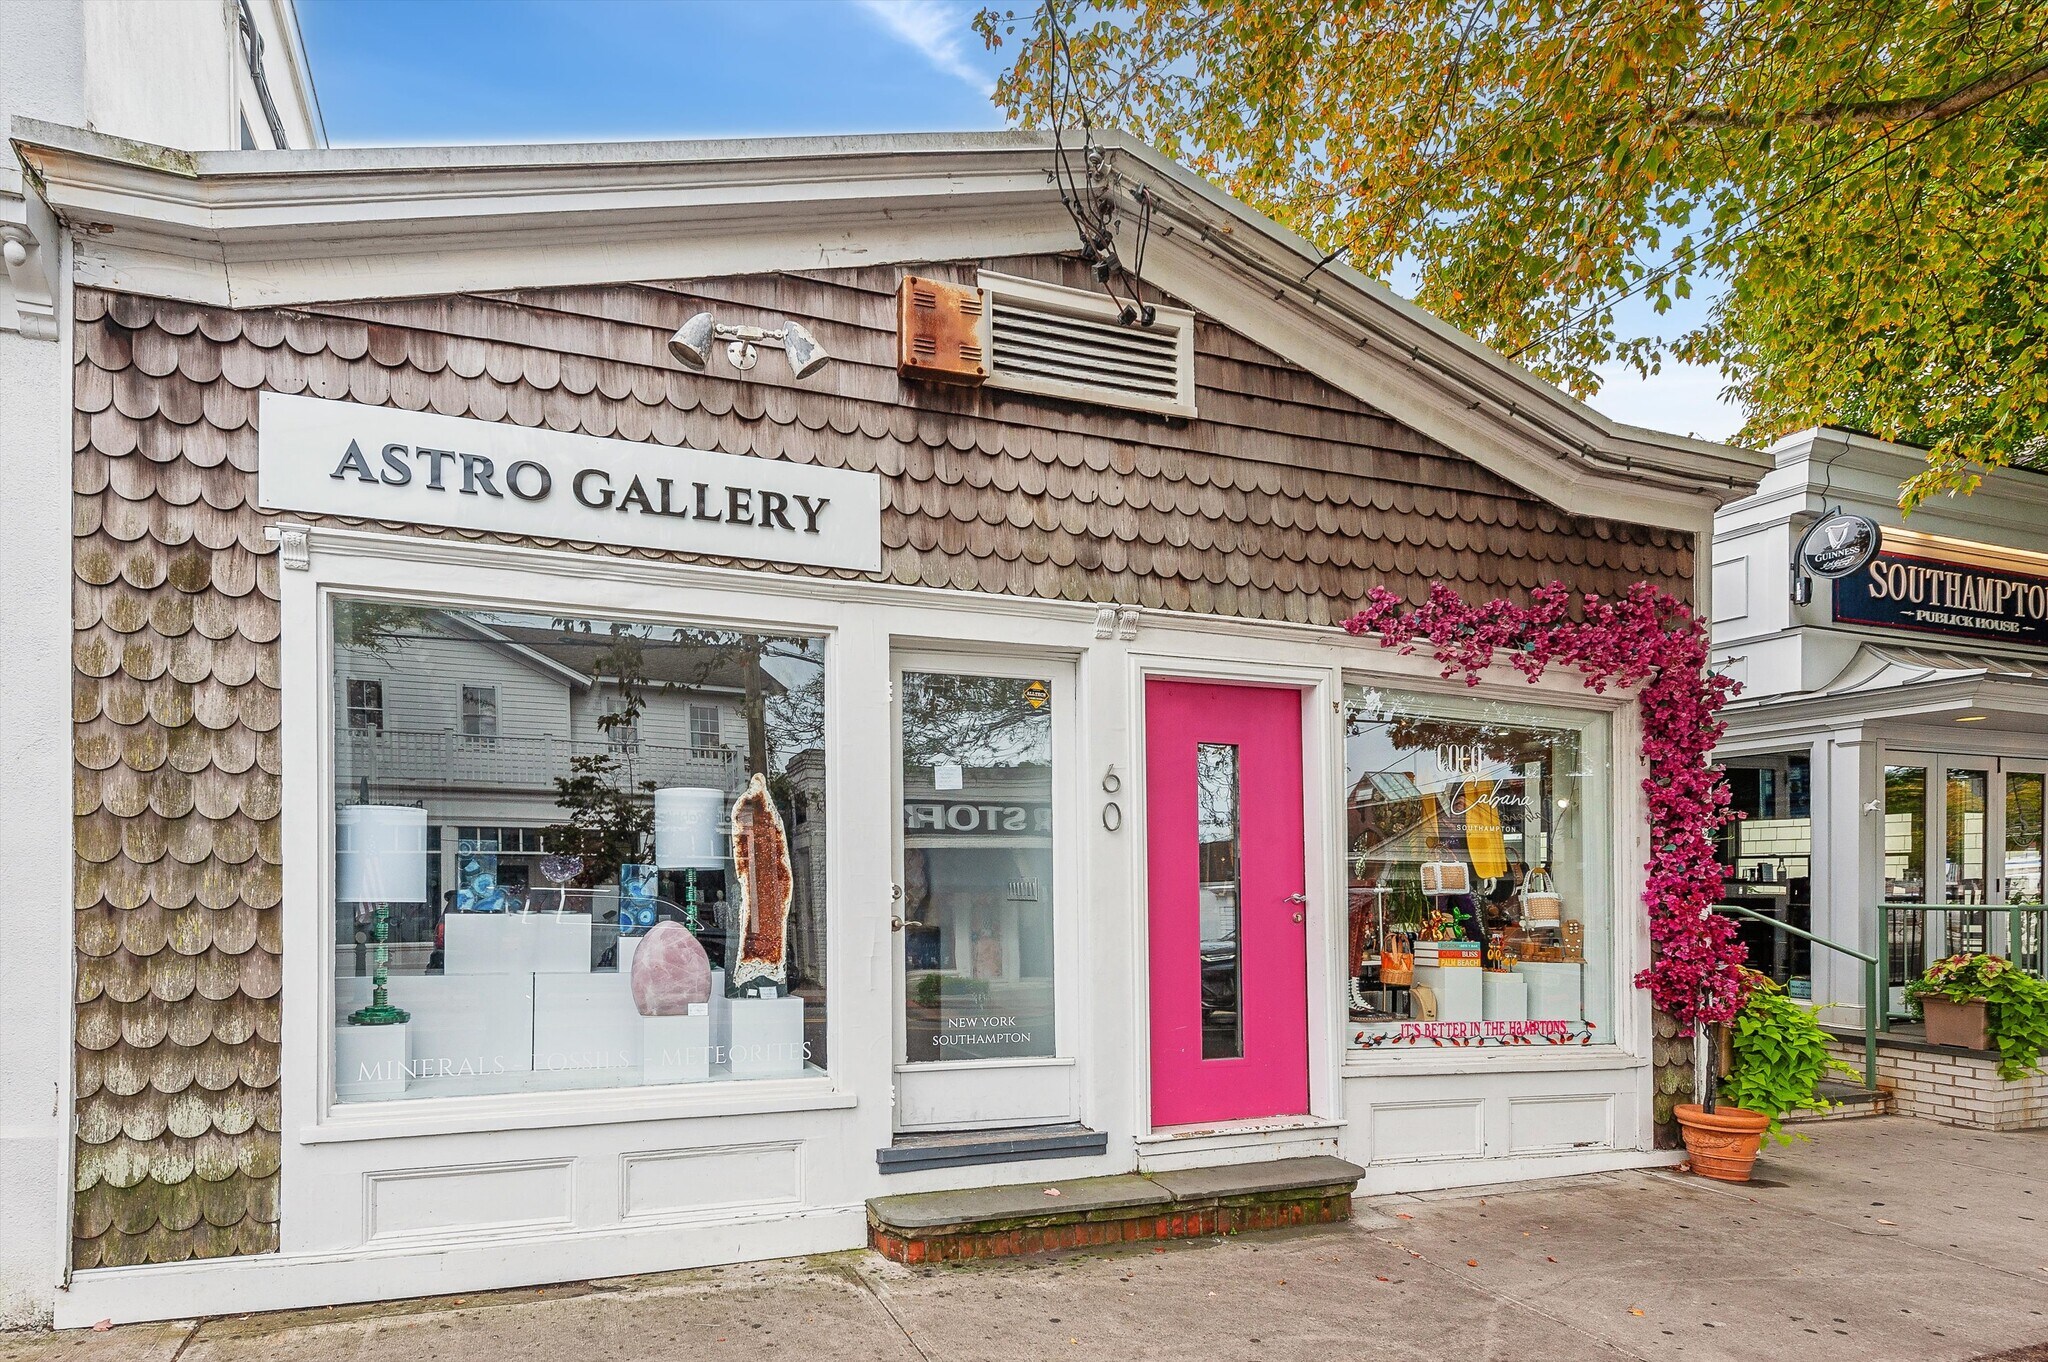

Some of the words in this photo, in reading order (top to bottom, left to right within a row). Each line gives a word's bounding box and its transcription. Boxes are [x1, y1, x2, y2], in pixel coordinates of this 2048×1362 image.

[329, 438, 552, 502] ASTRO
[572, 468, 830, 534] GALLERY
[1815, 546, 1861, 563] GUINNESS
[1868, 560, 2048, 621] SOUTHAMPTO
[1916, 609, 1974, 628] PUBLICK
[1975, 618, 2020, 633] HOUSE
[1437, 743, 1481, 774] COCO
[1451, 774, 1534, 815] Cabana
[1456, 824, 1517, 833] SOUTHAMPTON
[1457, 959, 1479, 967] BEACH
[948, 1018, 978, 1029] NEW
[981, 1016, 1017, 1027] YORK
[1401, 1023, 1421, 1039] IT'S
[1424, 1021, 1467, 1039] BETTER
[1470, 1022, 1481, 1037] IN
[1484, 1021, 1506, 1036] THE
[932, 1032, 1031, 1047] SOUTHAMPTON
[357, 1055, 505, 1082] MINERALS
[662, 1041, 812, 1067] METEORITES
